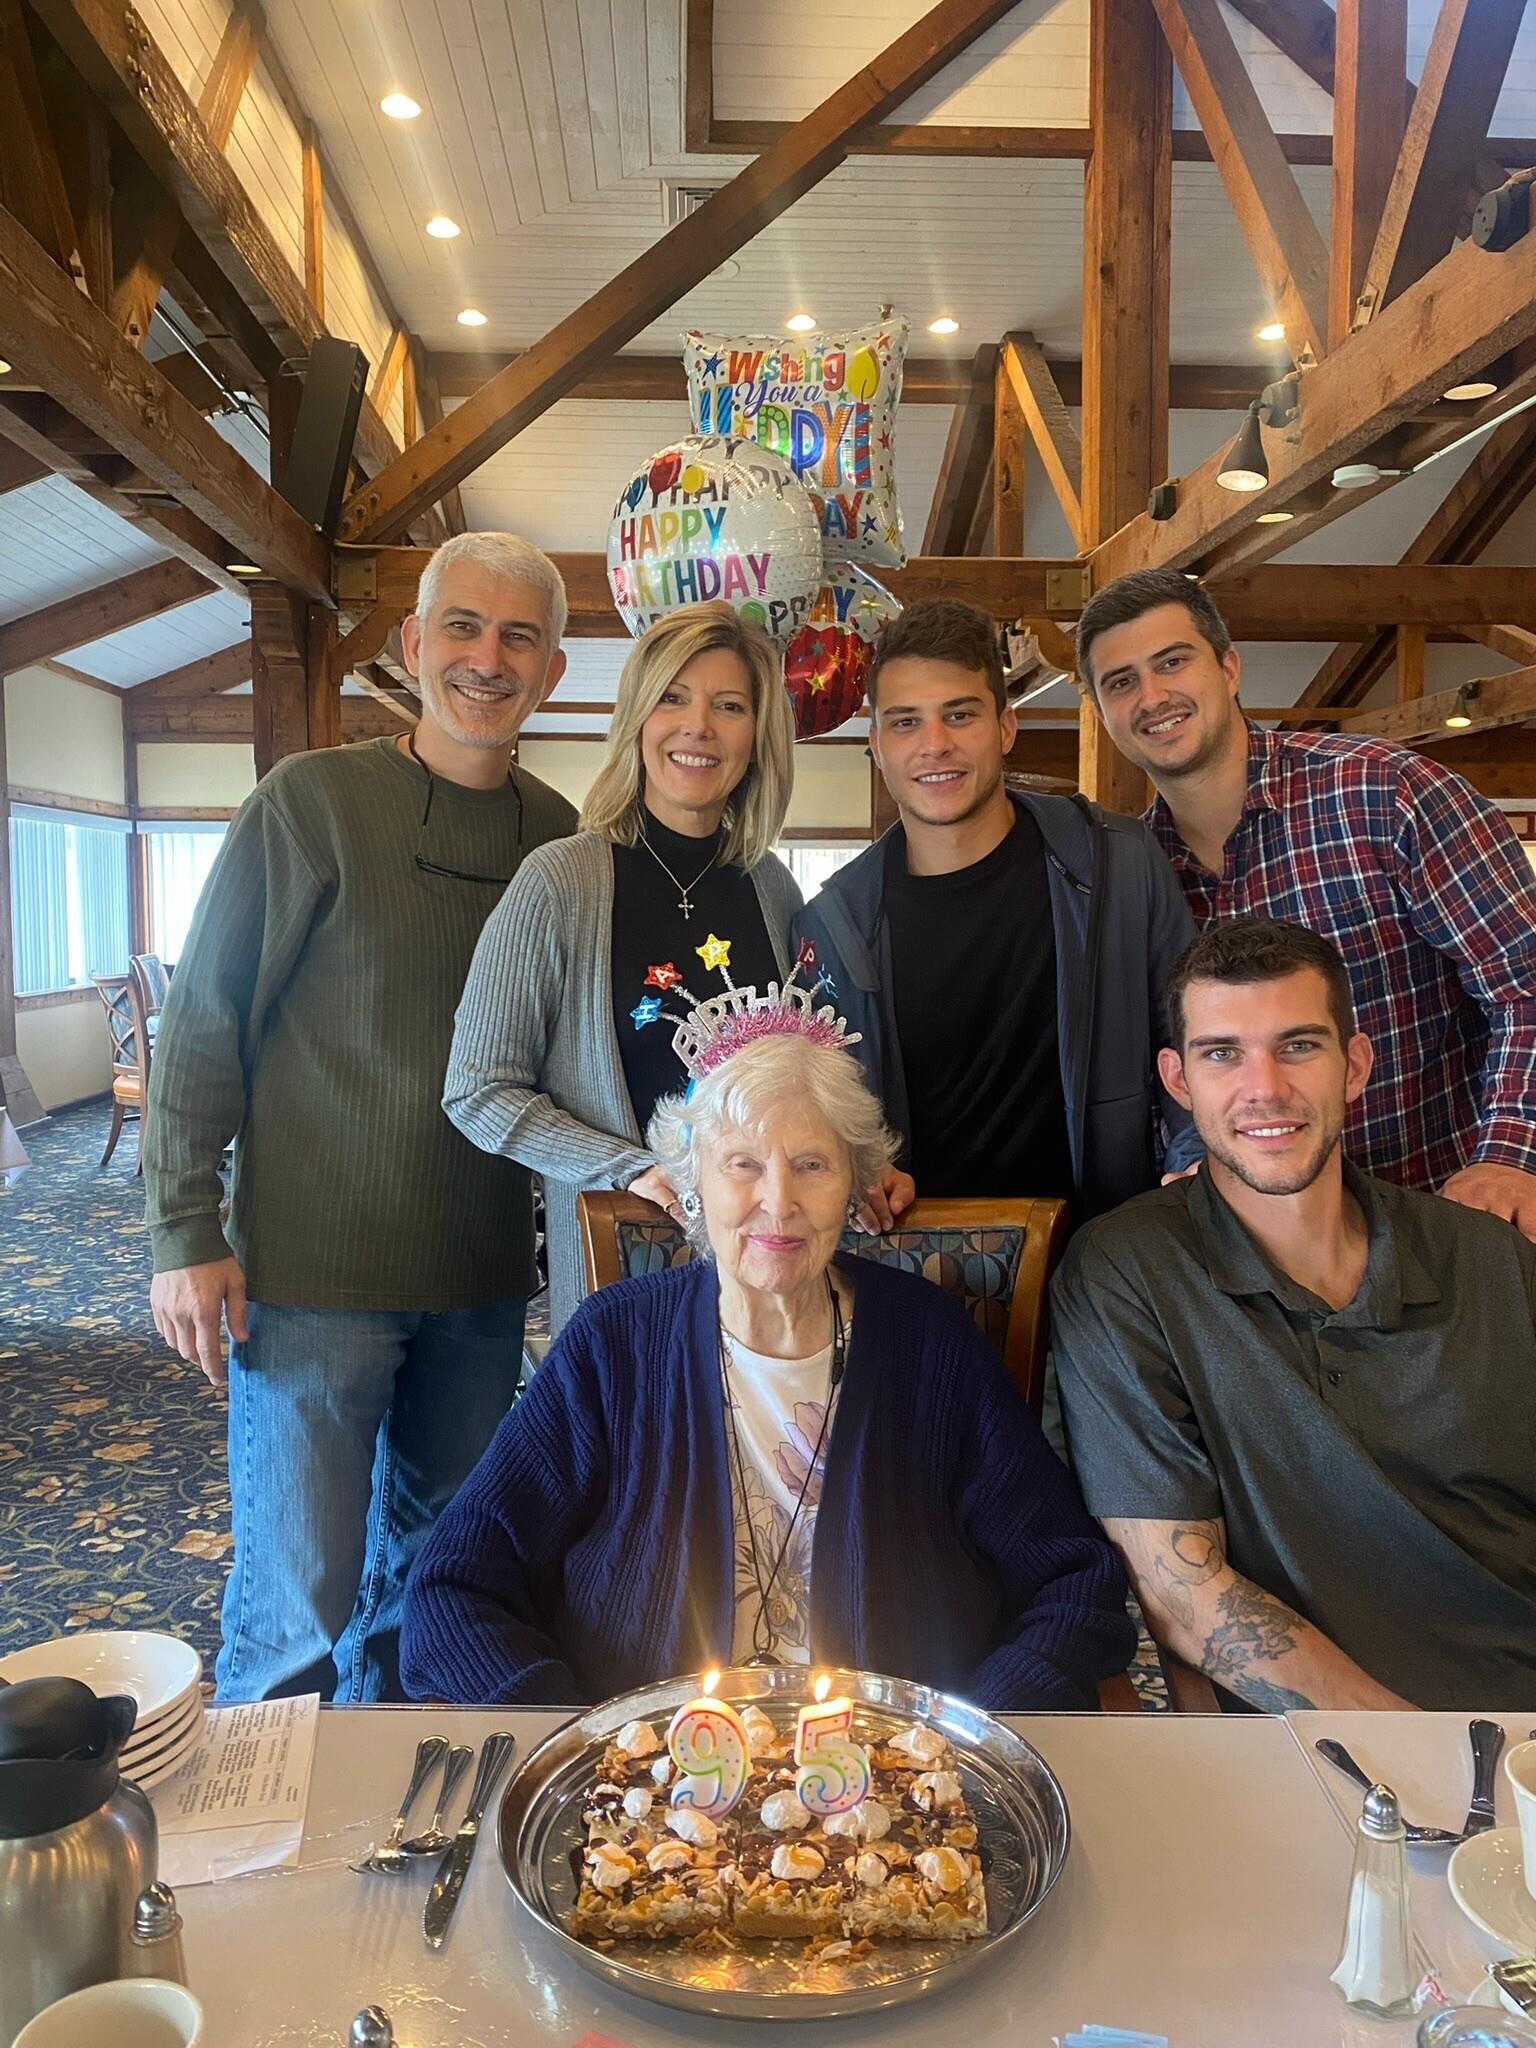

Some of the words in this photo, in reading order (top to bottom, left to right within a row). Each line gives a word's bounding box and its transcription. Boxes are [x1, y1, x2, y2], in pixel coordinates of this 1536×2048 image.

[735, 380, 798, 418] You
[803, 385, 823, 402] a
[620, 506, 727, 561] HAPPY
[612, 552, 772, 608] BIRTHDAY
